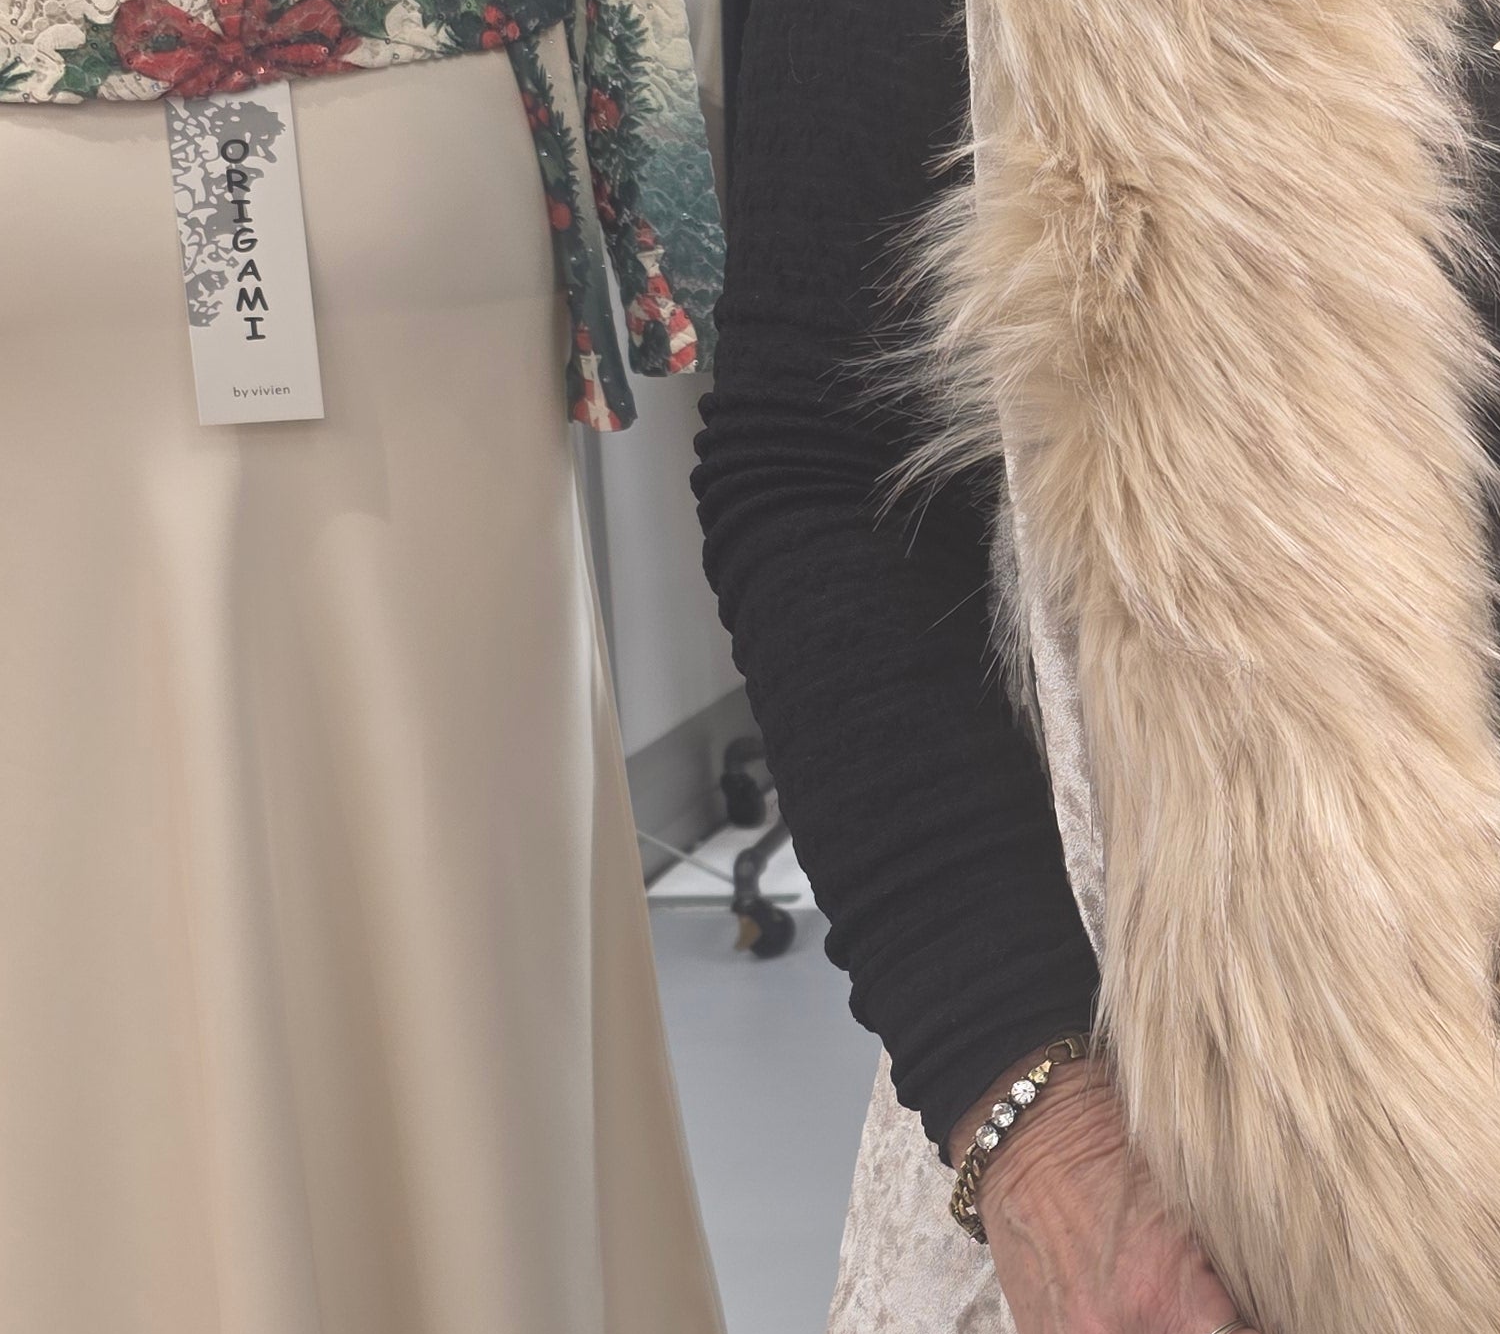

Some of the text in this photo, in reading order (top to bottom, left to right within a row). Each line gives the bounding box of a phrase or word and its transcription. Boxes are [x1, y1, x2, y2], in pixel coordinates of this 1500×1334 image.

[220, 138, 269, 341] ORIGAMI
[232, 384, 291, 399] by vivien
